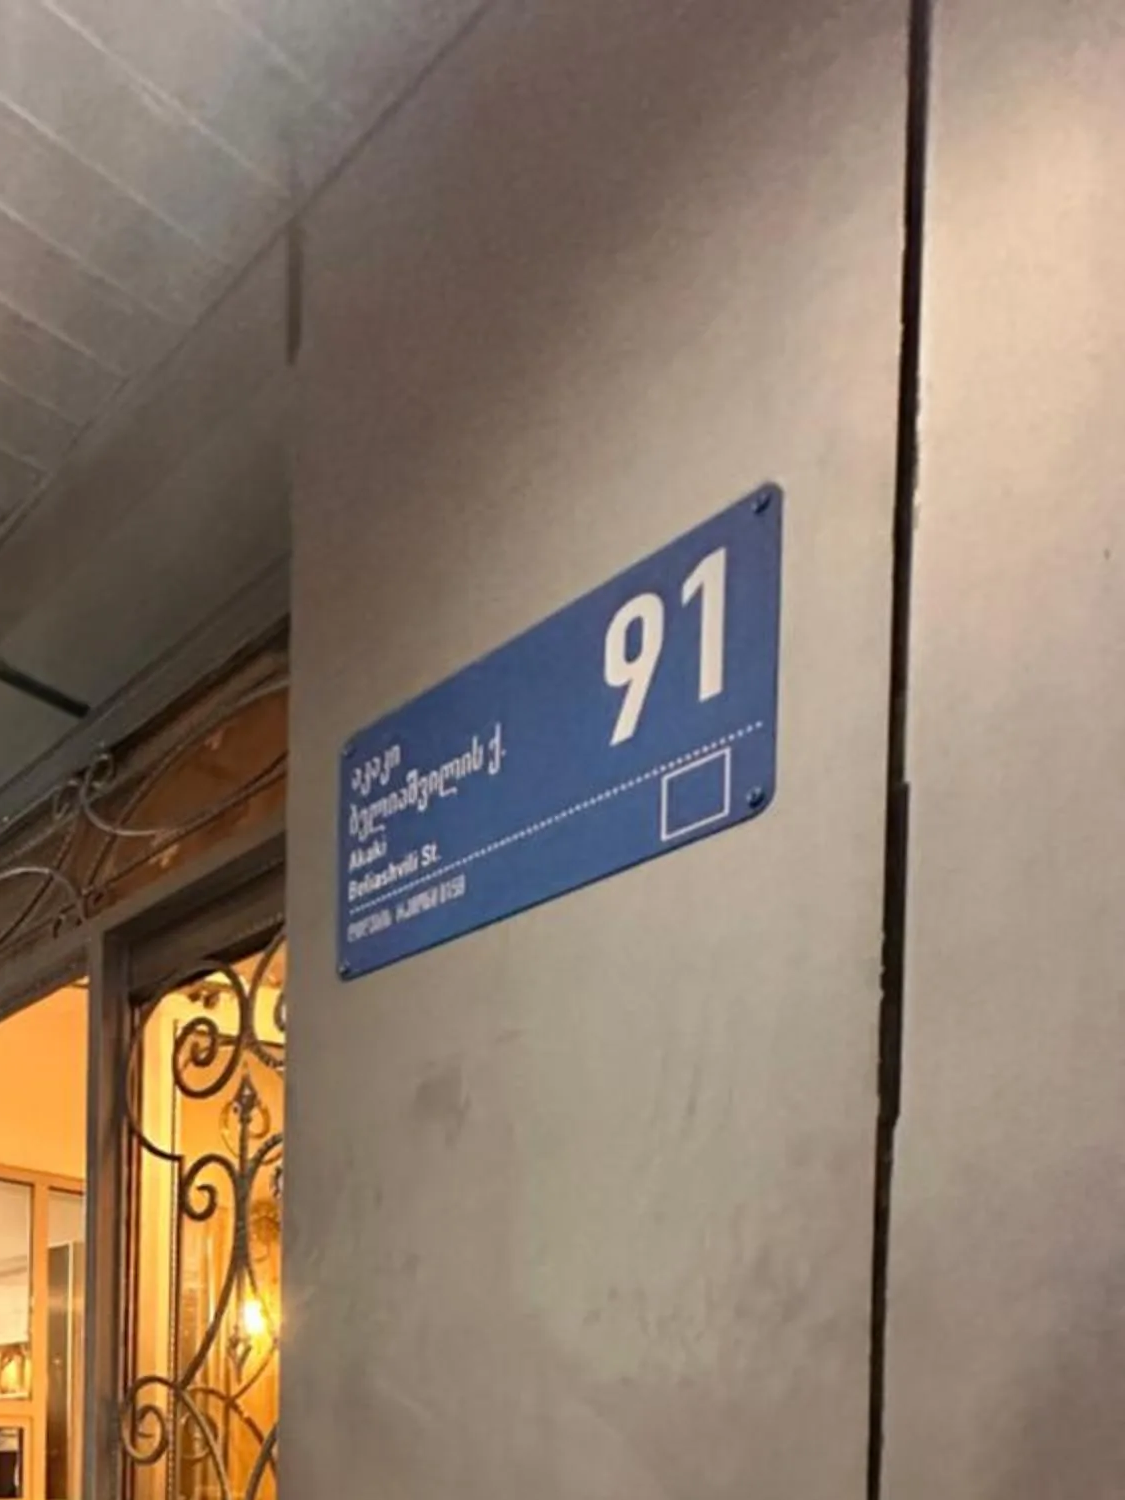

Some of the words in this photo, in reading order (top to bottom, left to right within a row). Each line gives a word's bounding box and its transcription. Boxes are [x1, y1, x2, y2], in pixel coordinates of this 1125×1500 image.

[604, 546, 727, 747] 91
[351, 744, 402, 797] აკაკი
[488, 721, 507, 776] ქ.
[348, 837, 388, 872] Akaki
[348, 849, 418, 902] Beliashvili
[420, 841, 442, 868] St.
